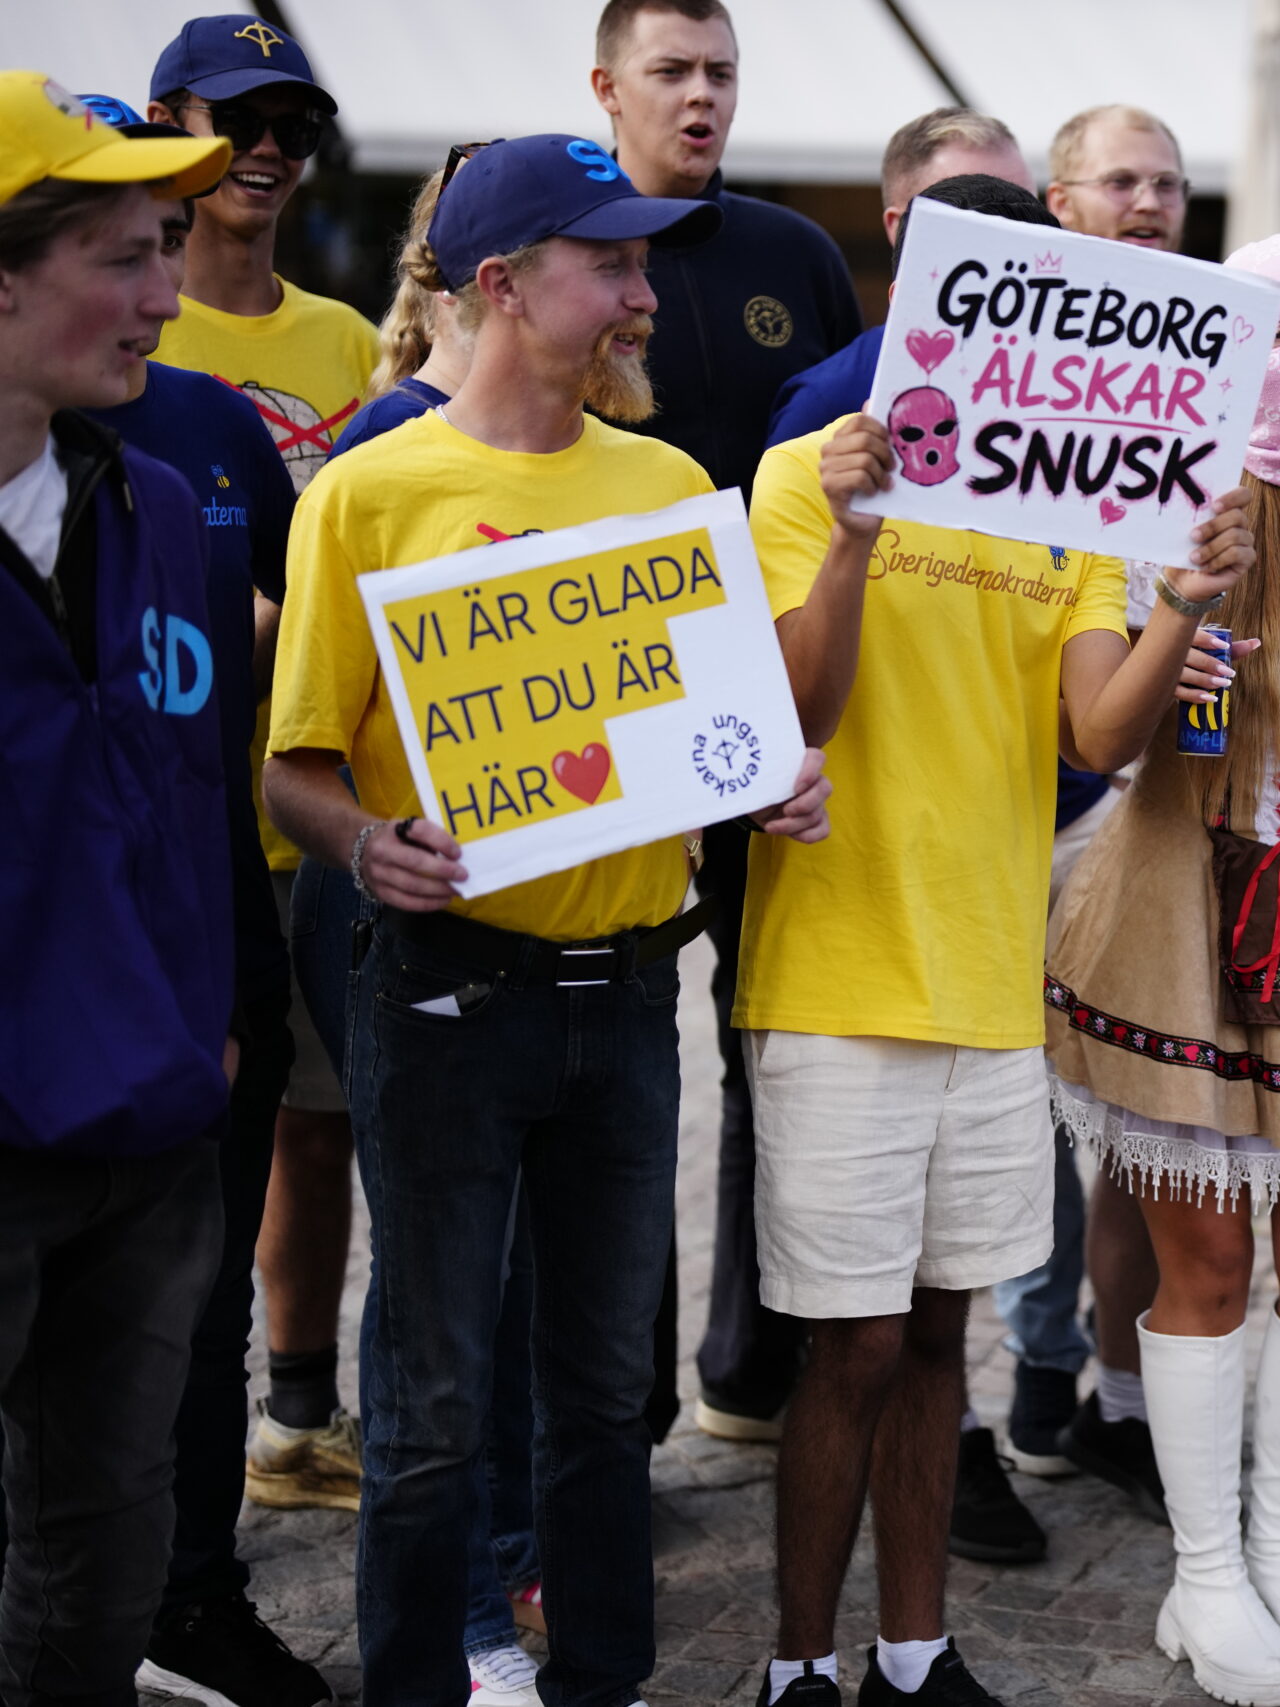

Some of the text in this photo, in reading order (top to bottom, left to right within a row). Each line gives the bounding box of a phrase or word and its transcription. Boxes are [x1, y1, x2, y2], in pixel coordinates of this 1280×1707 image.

[566, 139, 633, 183] S
[937, 259, 1228, 368] GÖTEBORG
[971, 333, 1207, 427] ÄLSKAR
[967, 421, 1217, 507] SNUSK
[391, 547, 722, 664] VI ÄR GLADA
[138, 607, 214, 716] SD
[425, 639, 681, 752] ATT DU ÄR
[442, 763, 556, 836] HÄR
[692, 714, 762, 797] ungsvenskarna
